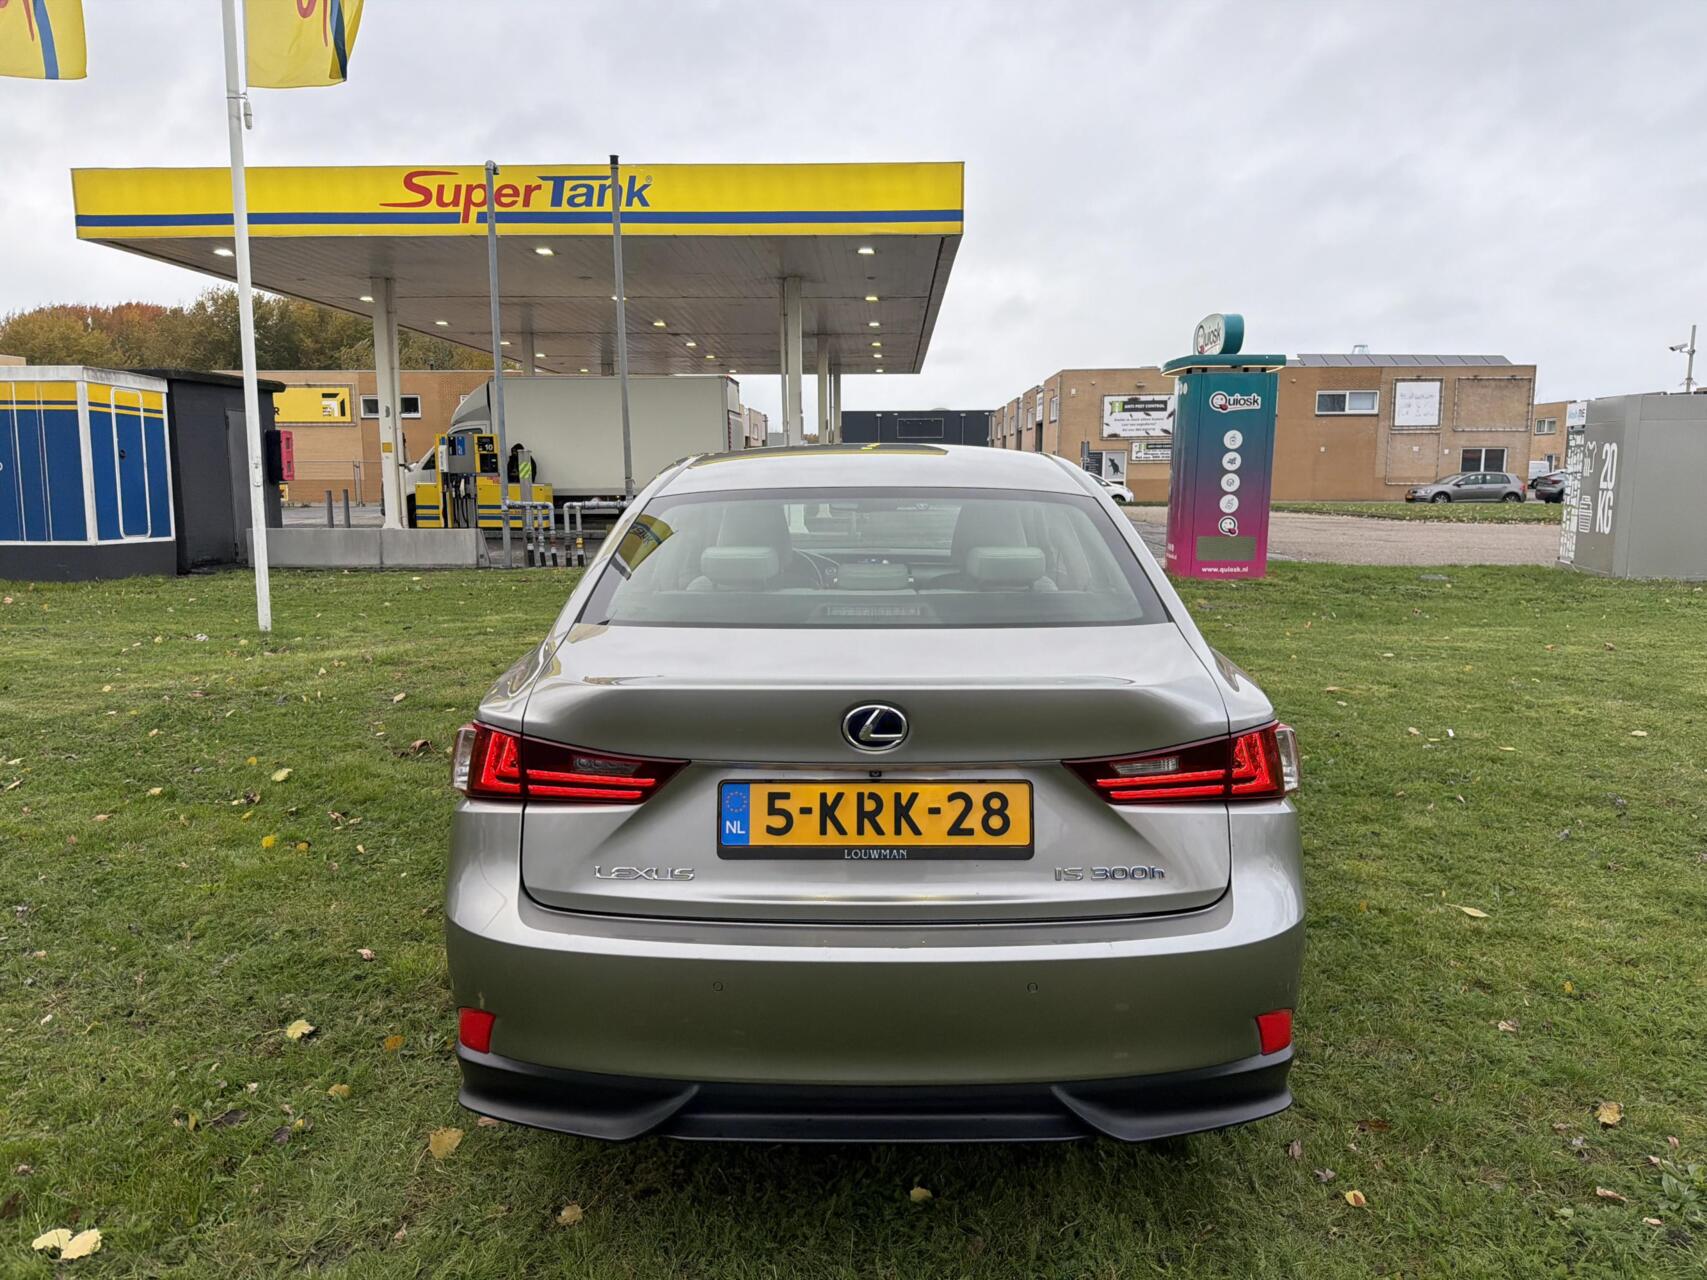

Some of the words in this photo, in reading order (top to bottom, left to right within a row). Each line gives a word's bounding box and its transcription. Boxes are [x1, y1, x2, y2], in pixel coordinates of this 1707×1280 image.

[1196, 322, 1221, 353] Quiosk
[1211, 393, 1259, 410] Quiosk
[1599, 442, 1618, 490] 20
[1595, 490, 1614, 535] KG
[1201, 565, 1249, 574] www.quiosk.nl
[725, 820, 746, 835] NL
[765, 791, 1012, 837] 5-KRK-28
[844, 848, 907, 860] LOUWMAN
[594, 866, 695, 881] LEXUS
[1054, 867, 1084, 882] IS
[1091, 865, 1165, 881] 300h
